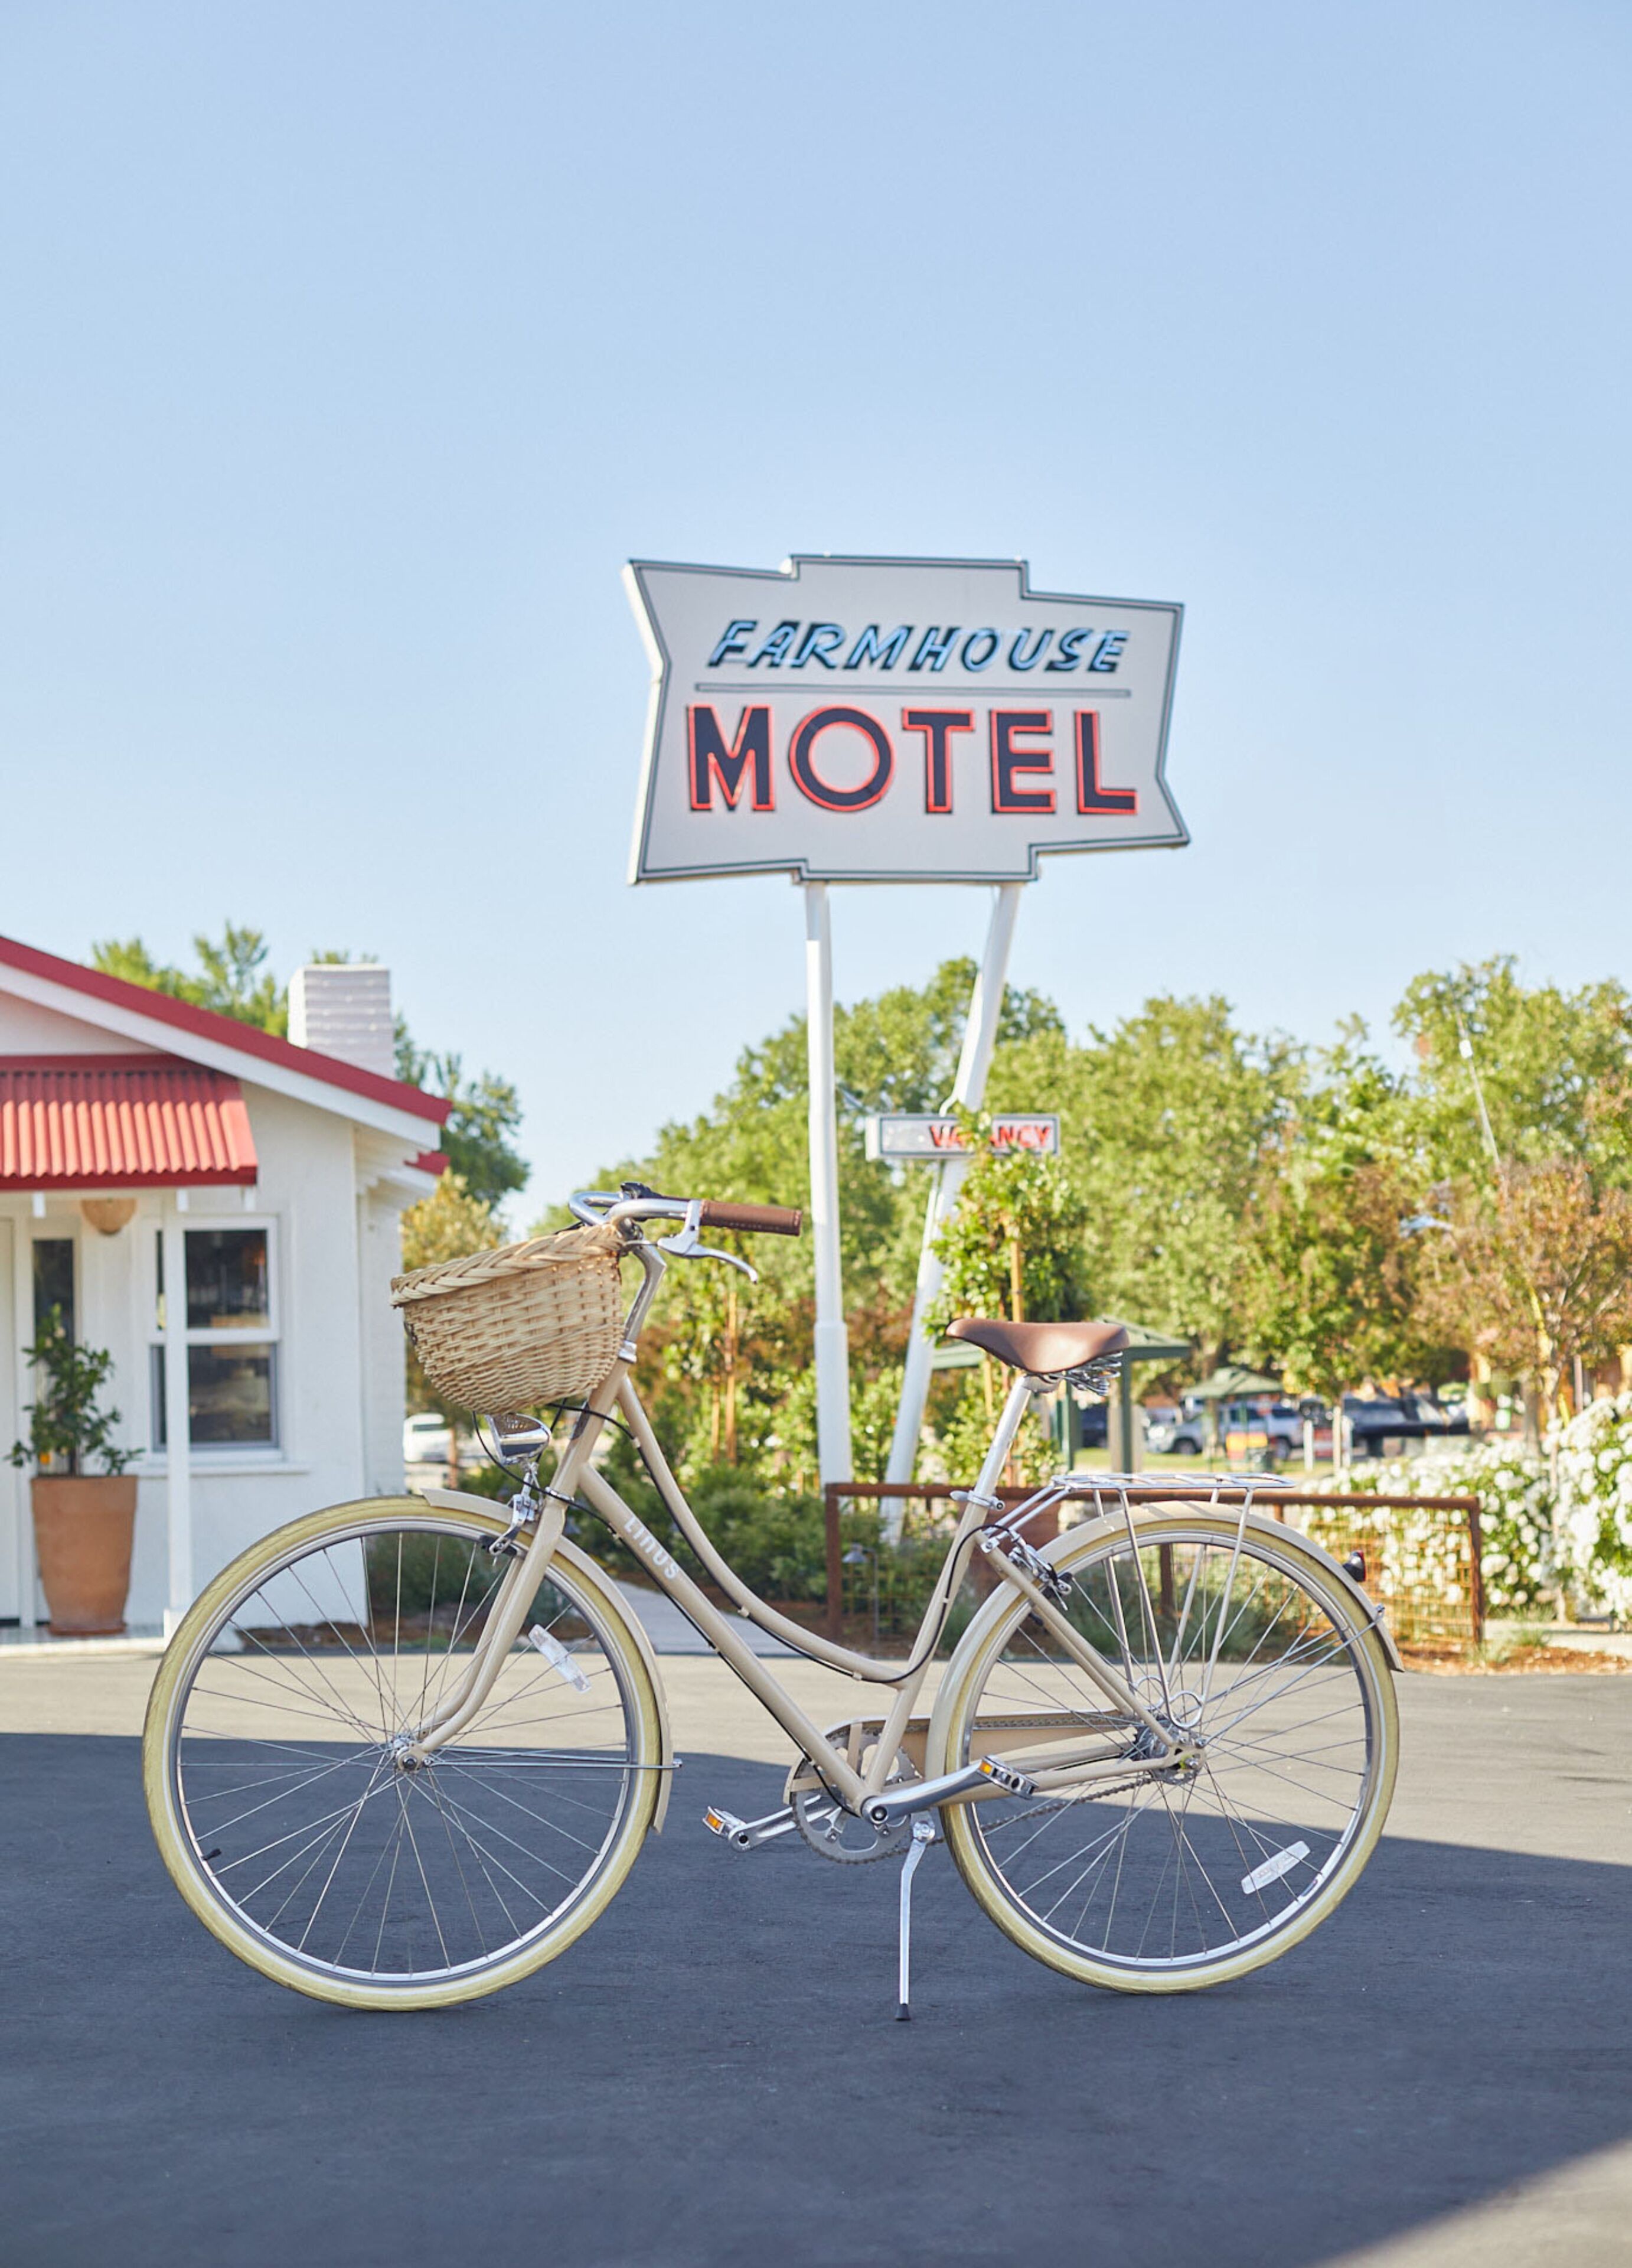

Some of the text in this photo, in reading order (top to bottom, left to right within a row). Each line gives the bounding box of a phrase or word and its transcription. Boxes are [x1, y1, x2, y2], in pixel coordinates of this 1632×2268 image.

[707, 619, 1130, 673] FARMHOUSE
[686, 705, 1138, 814] MOTEL
[929, 1125, 1050, 1148] VANCY
